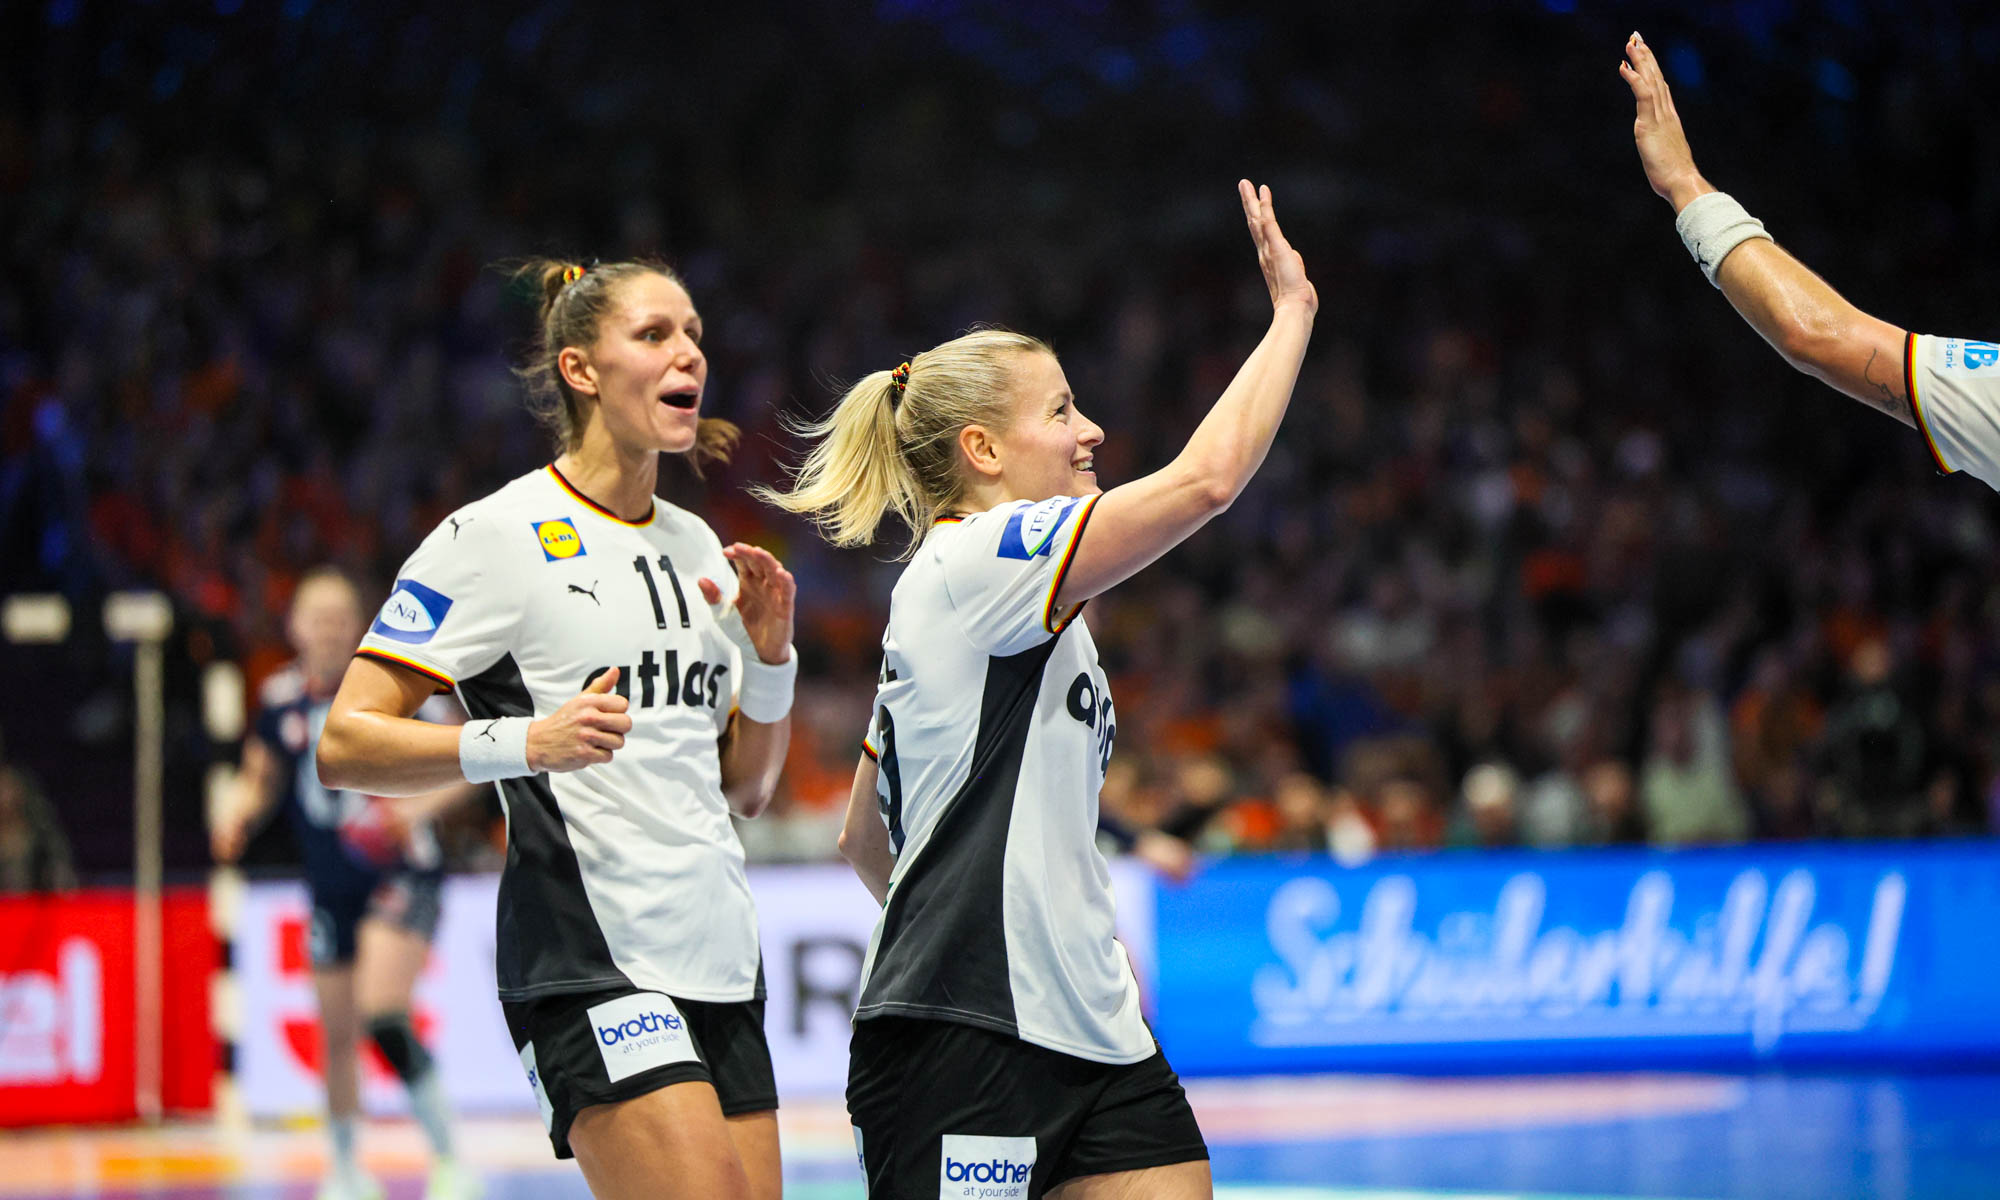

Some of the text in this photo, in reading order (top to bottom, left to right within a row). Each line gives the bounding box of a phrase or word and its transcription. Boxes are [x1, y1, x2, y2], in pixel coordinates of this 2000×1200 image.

[633, 555, 690, 629] 11
[581, 650, 728, 709] atlas
[598, 1011, 683, 1046] brother
[623, 1043, 634, 1054] at
[636, 1036, 660, 1051] your
[946, 1157, 1033, 1183] brother
[963, 1186, 1021, 1200] at your side
